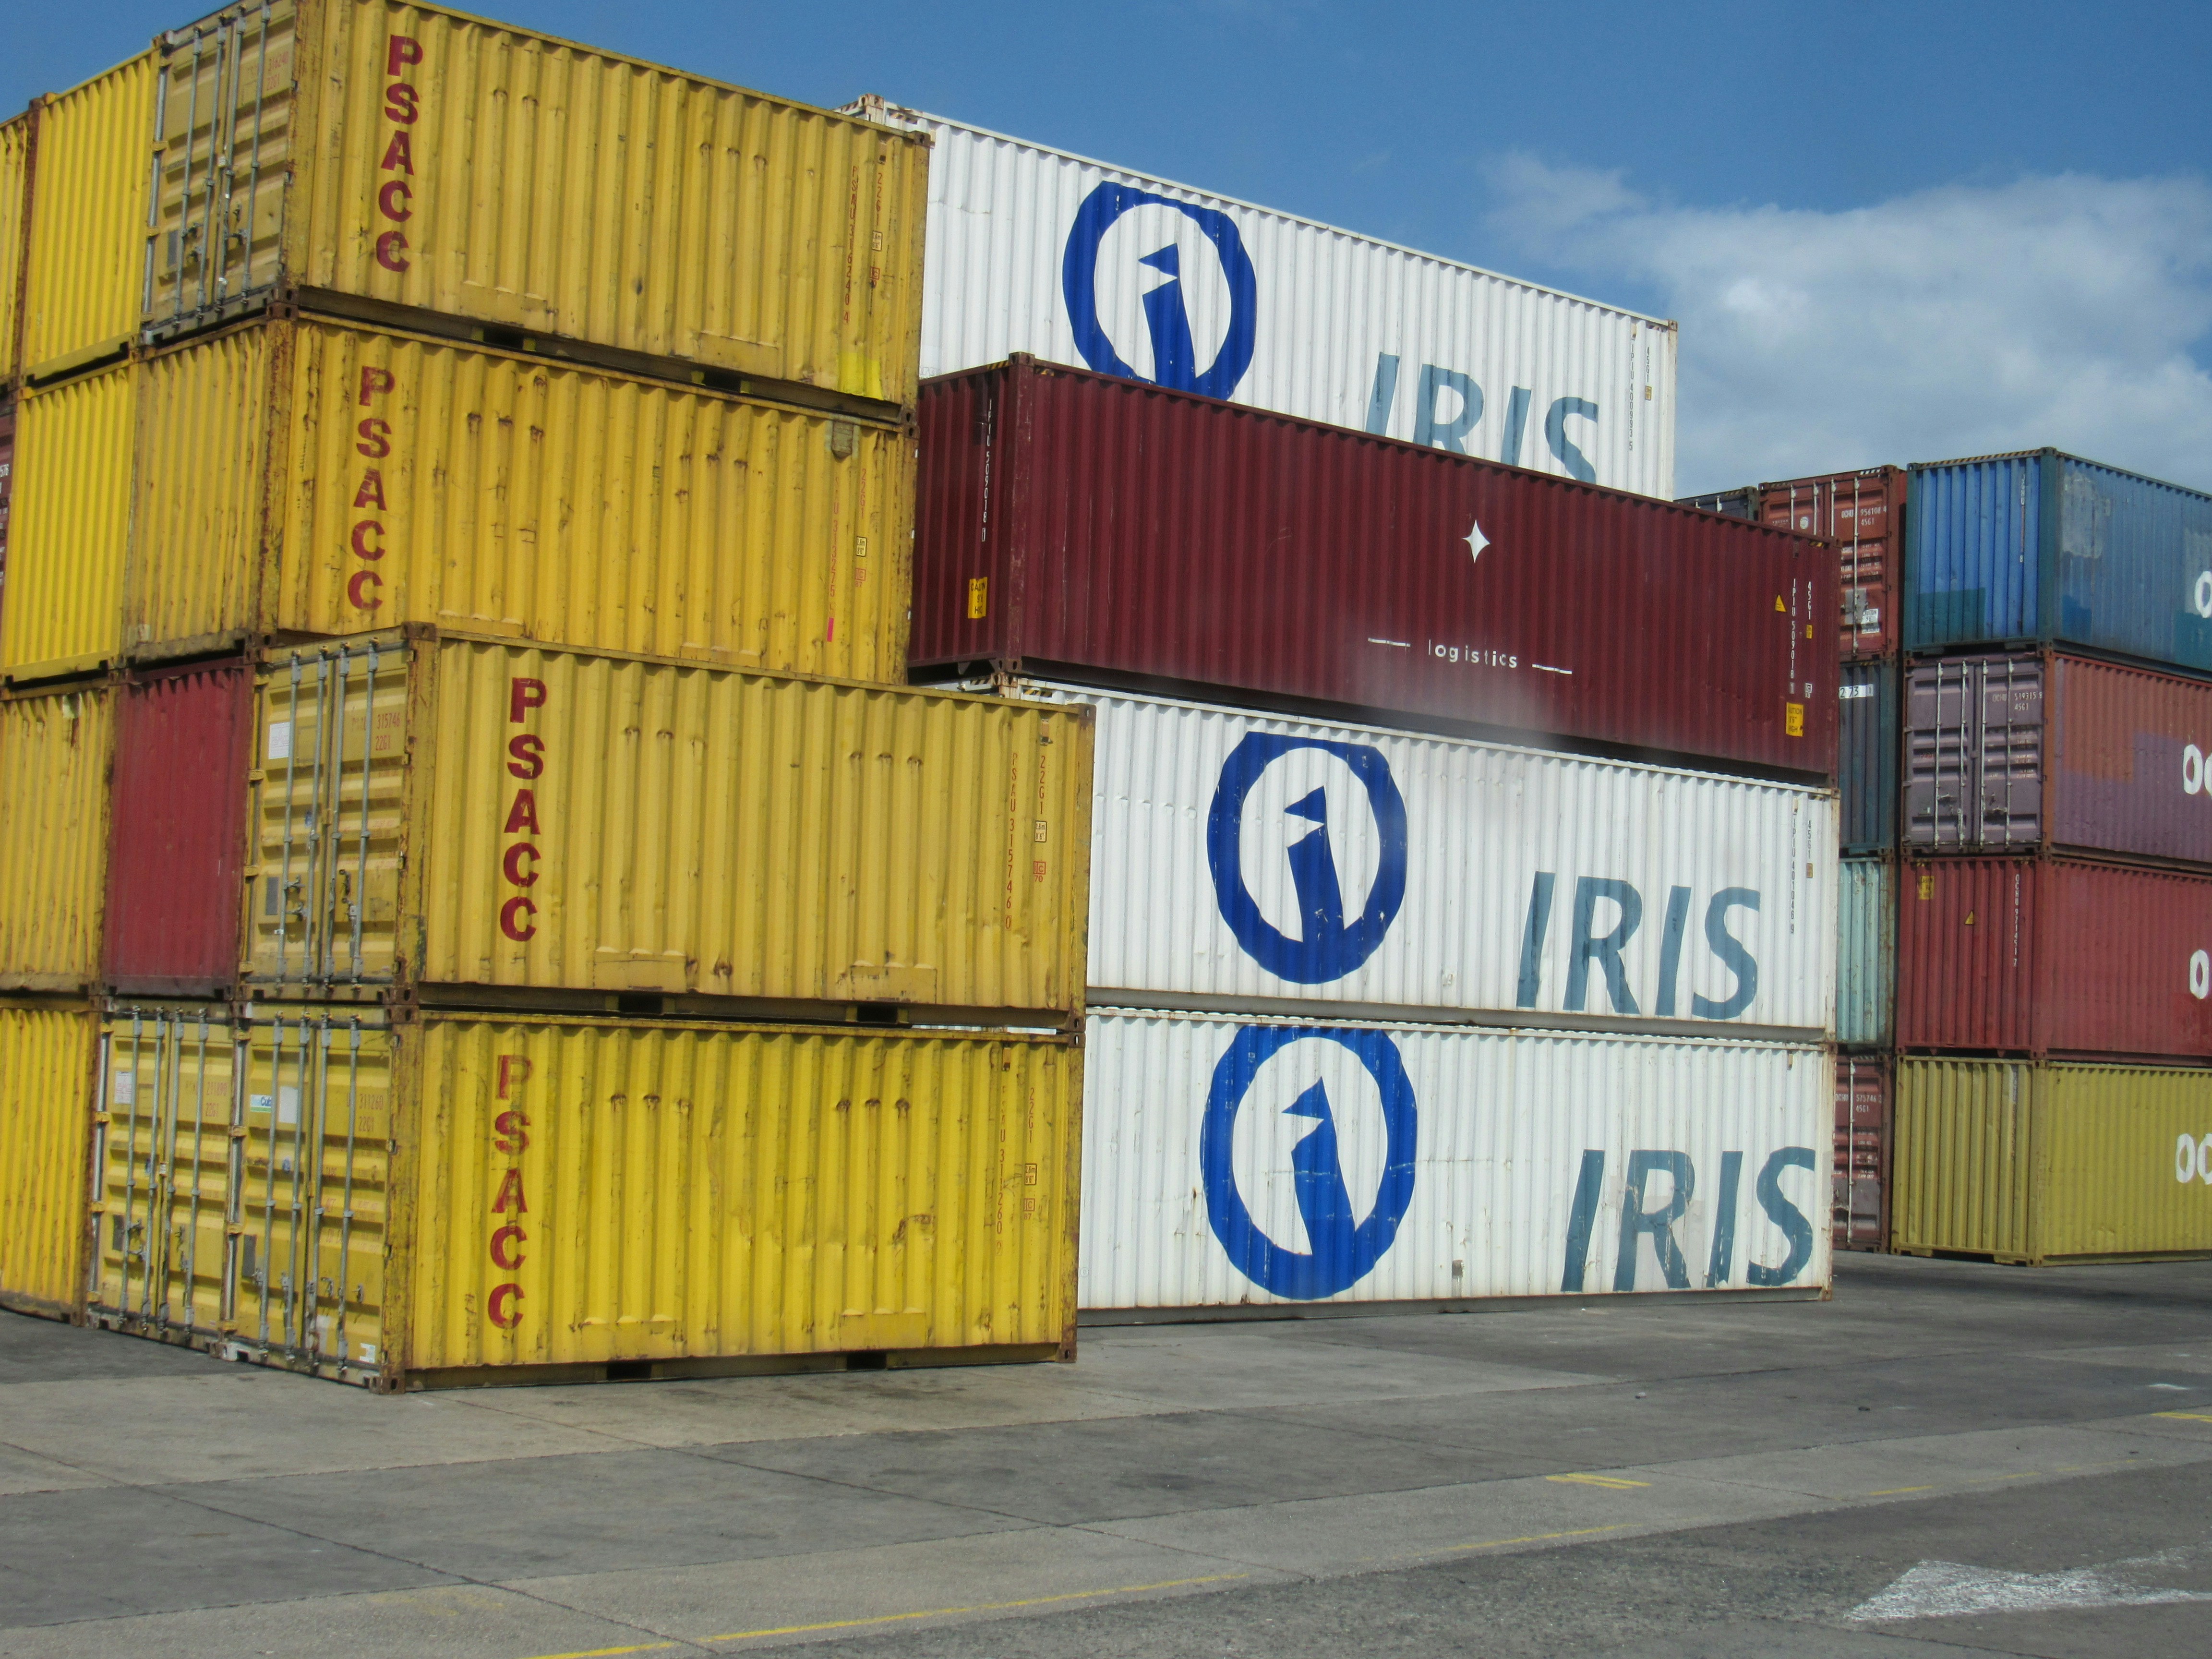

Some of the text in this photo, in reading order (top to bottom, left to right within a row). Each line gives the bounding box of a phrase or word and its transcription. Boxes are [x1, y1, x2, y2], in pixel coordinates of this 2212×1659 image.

[377, 35, 423, 273] PSACC
[349, 367, 396, 610] PSACC
[1365, 351, 1599, 484] IRIS
[1429, 639, 1517, 668] logistics
[500, 679, 547, 942] PSACC
[1007, 818, 1015, 909] 315746
[1516, 871, 1761, 1020] IRIS
[488, 1055, 534, 1329] PSACC
[997, 1149, 1005, 1234] 311260
[1562, 1147, 1816, 1292] IRIS
